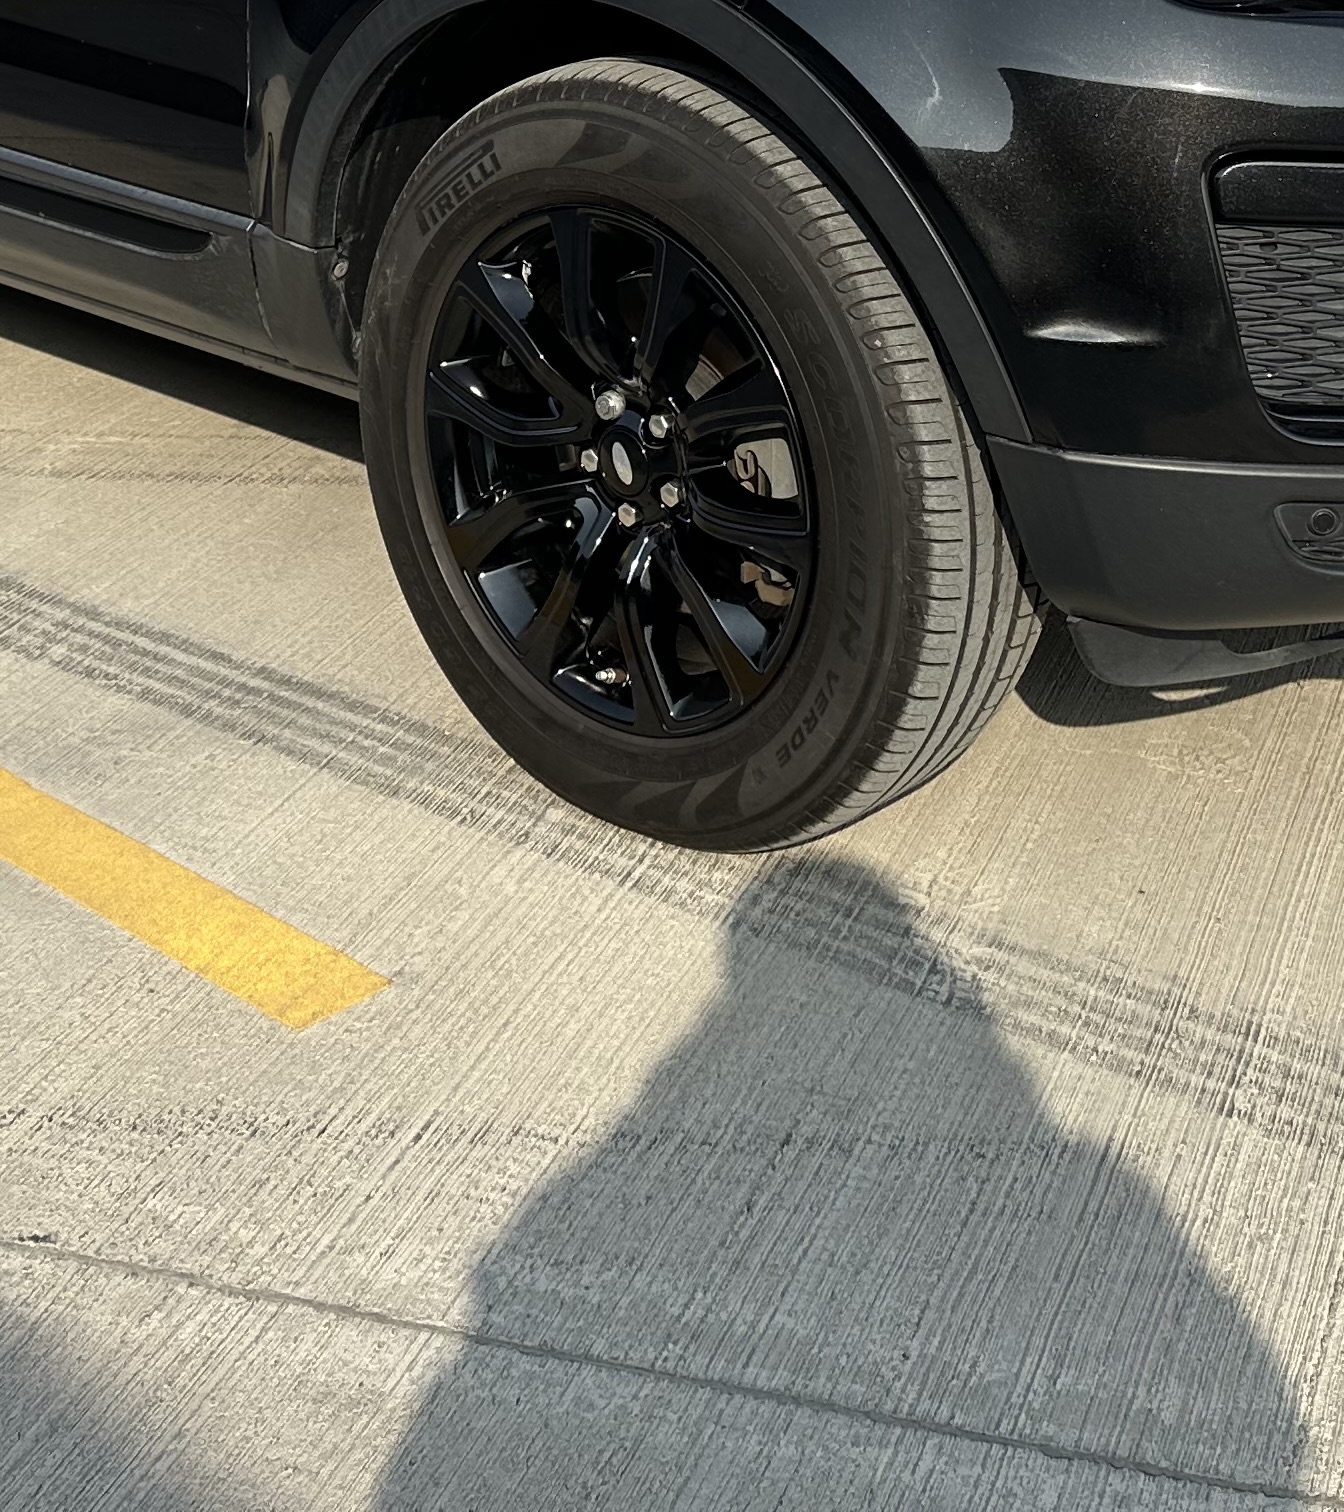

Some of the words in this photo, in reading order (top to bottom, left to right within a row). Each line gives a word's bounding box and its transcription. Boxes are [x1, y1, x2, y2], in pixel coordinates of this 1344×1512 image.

[416, 139, 502, 236] PIRELLI
[783, 307, 868, 659] SCORPION
[775, 670, 840, 768] VERDE
